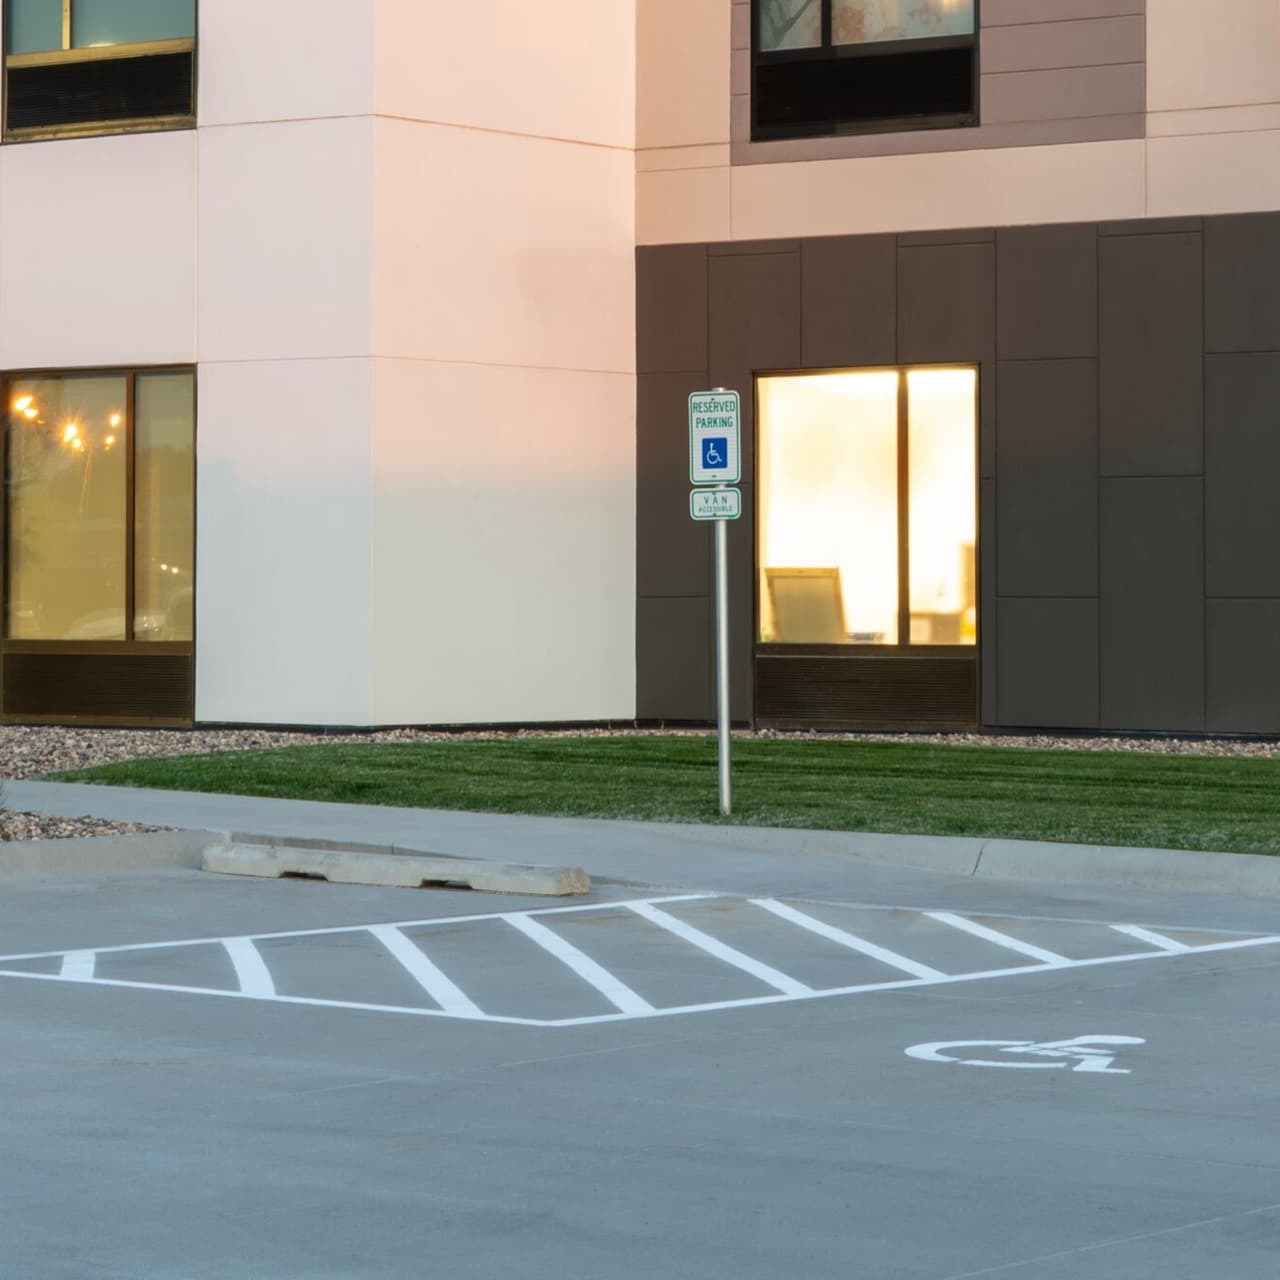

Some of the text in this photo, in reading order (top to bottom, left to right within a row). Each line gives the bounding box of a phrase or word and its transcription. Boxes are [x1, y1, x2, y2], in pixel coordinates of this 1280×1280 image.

[693, 400, 735, 413] RESERVED
[696, 416, 733, 428] PARKING
[704, 496, 727, 505] VAN
